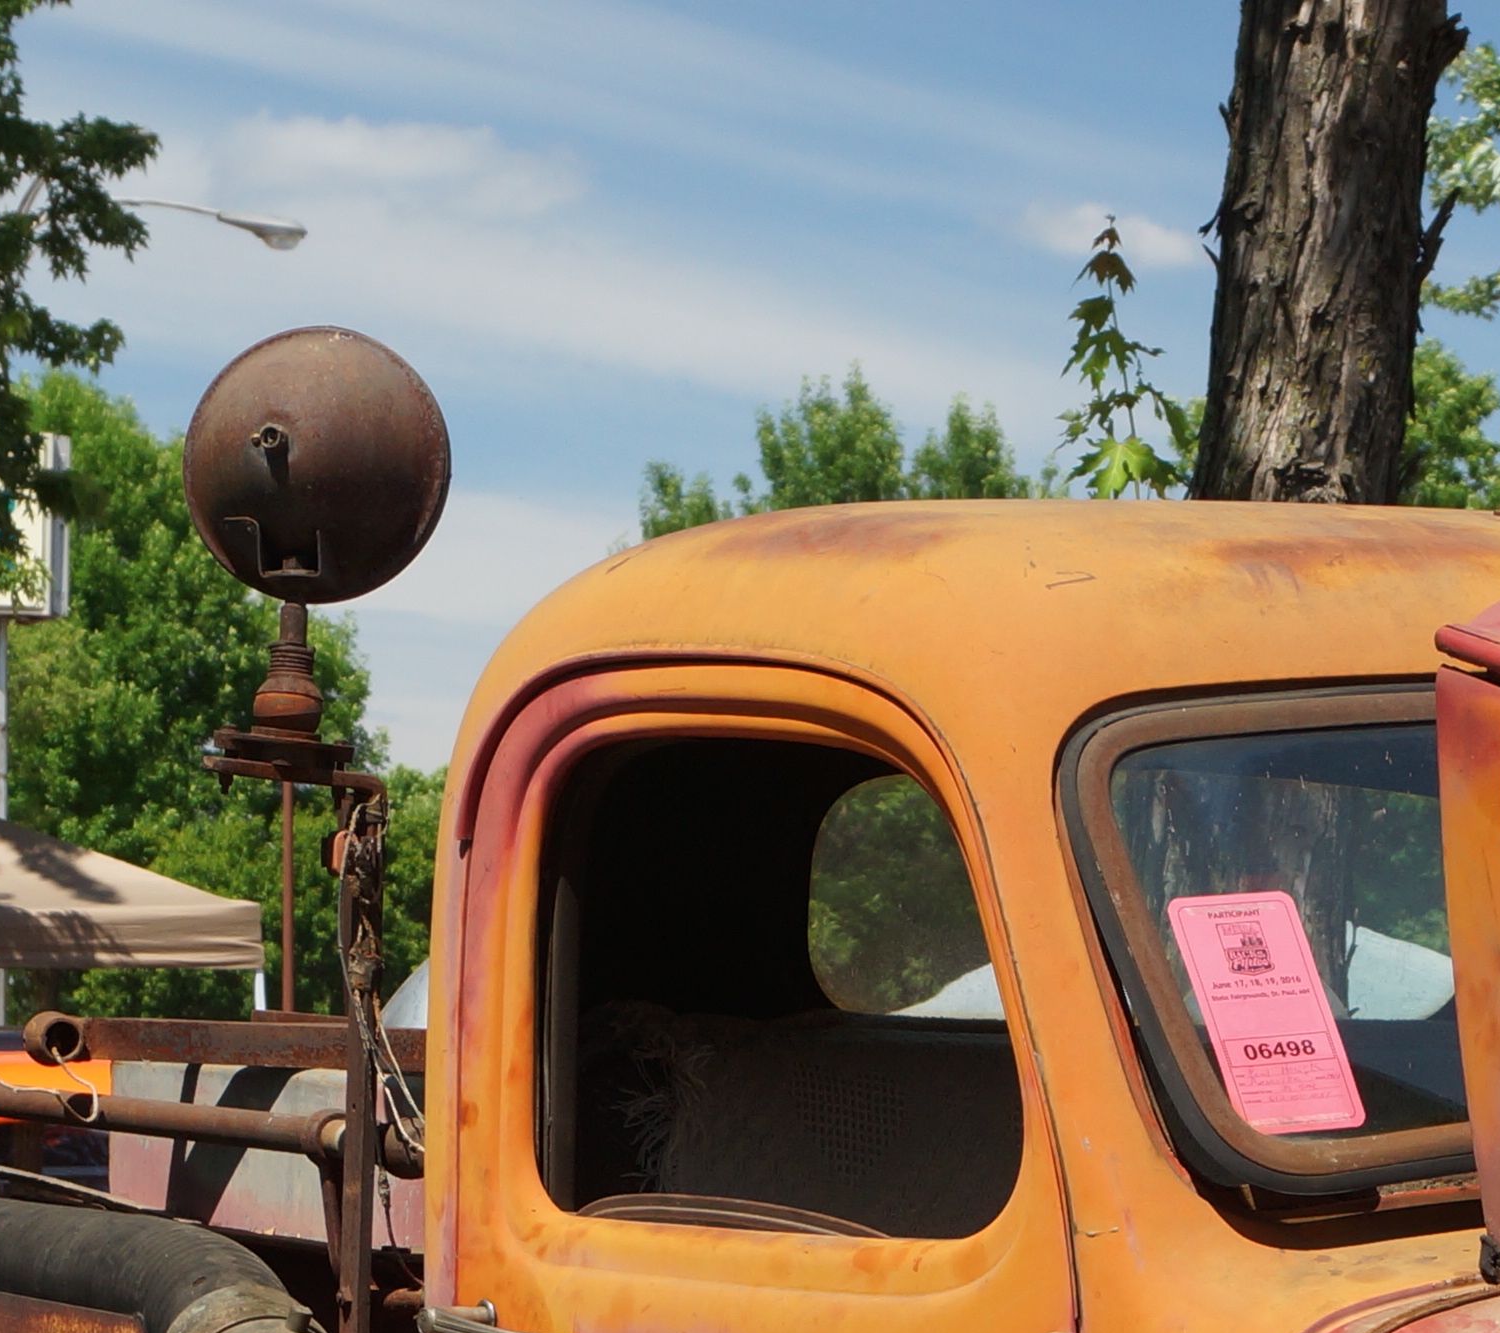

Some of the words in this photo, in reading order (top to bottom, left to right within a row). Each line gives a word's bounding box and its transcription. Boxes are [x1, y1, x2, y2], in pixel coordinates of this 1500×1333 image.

[1207, 908, 1260, 920] PARTICIPANT
[1280, 975, 1302, 984] 2016
[1243, 1039, 1316, 1061] 06498
